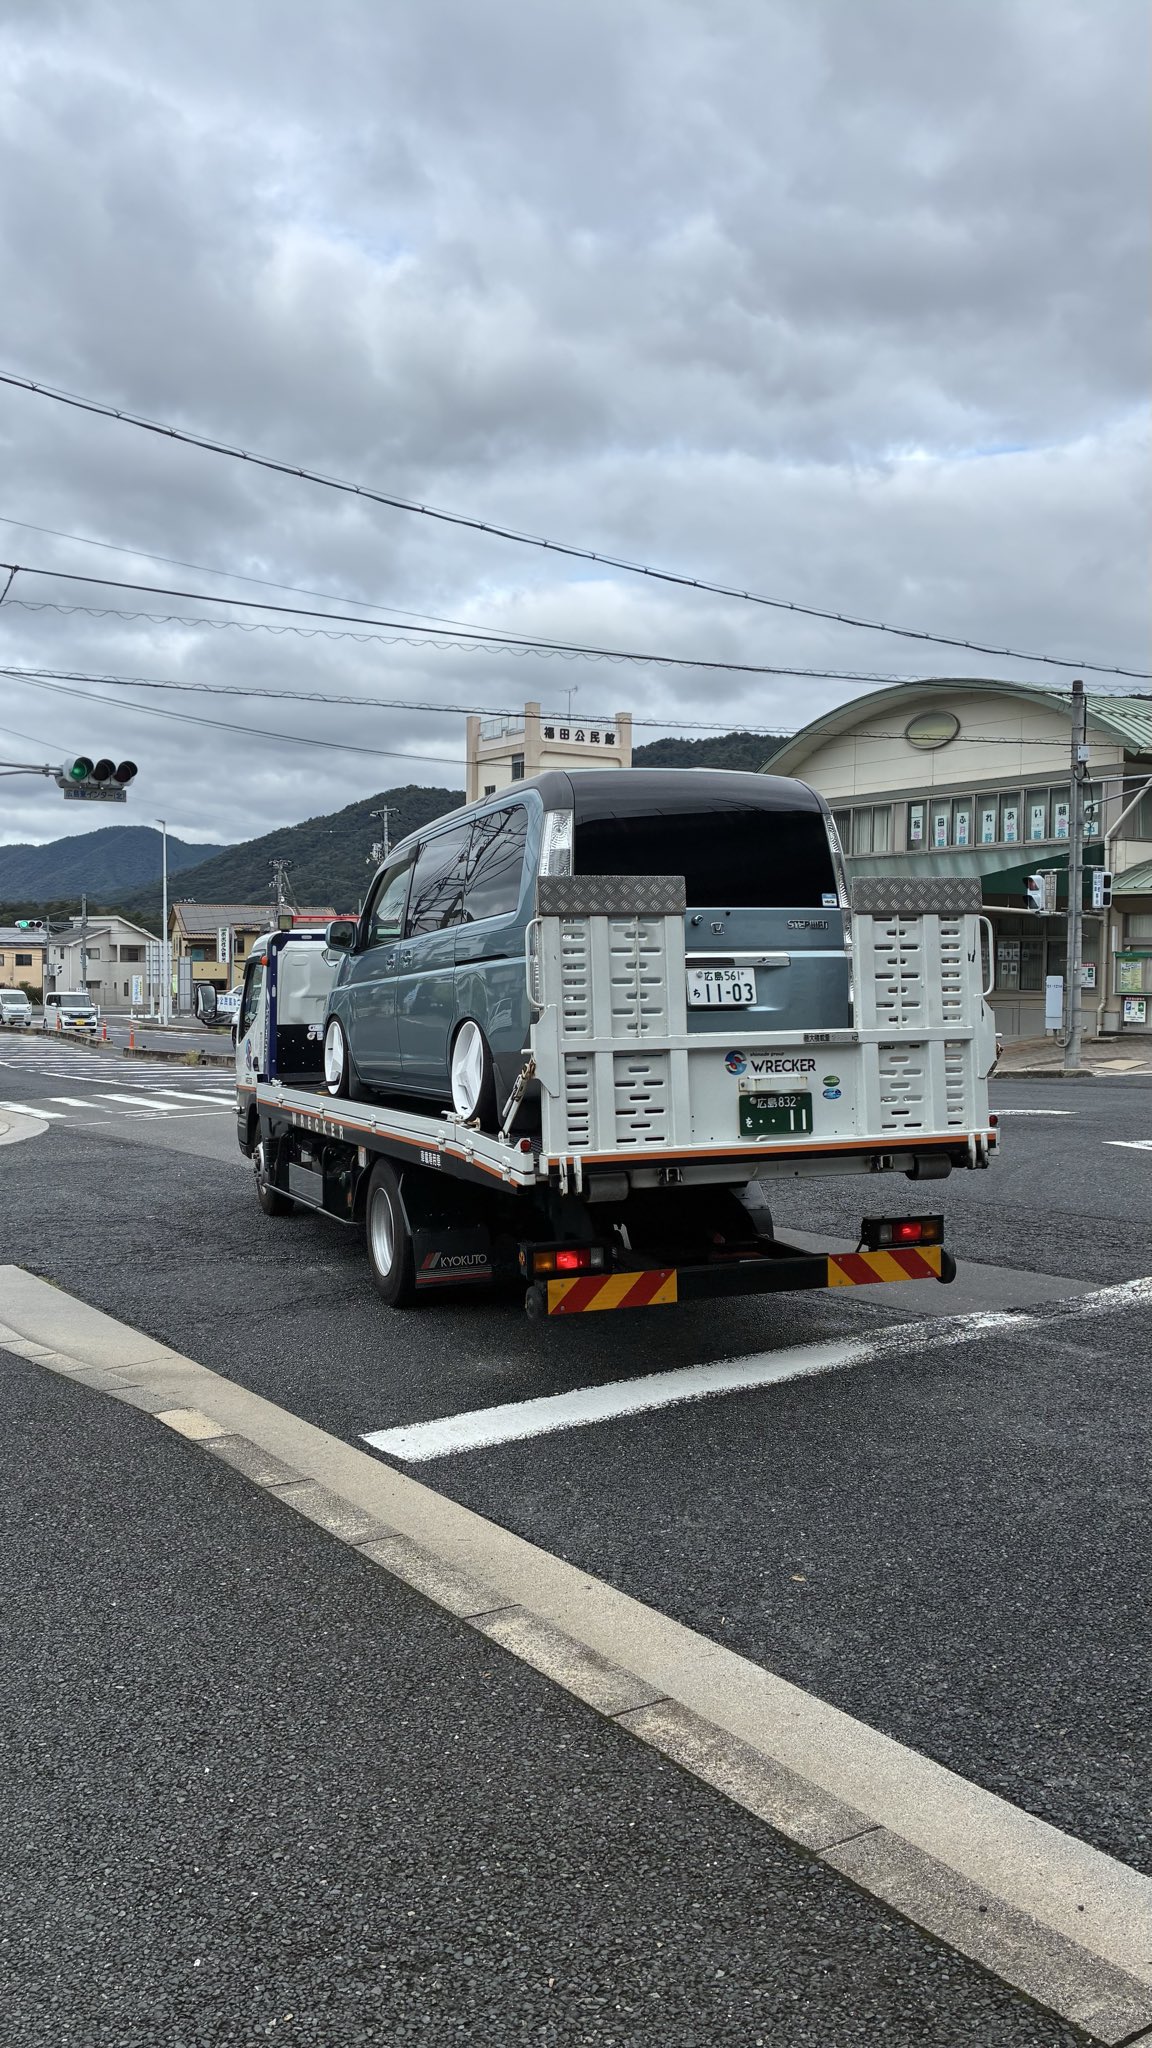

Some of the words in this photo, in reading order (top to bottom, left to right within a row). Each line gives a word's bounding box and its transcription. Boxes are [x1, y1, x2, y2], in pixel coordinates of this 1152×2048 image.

[544, 726, 615, 745] 福田公民館
[693, 988, 701, 998] ち
[706, 983, 753, 1002] 11-03
[751, 1059, 816, 1073] WRECKER
[292, 1111, 344, 1140] WRECKER
[745, 1117, 753, 1128] を
[440, 1254, 487, 1268] KYOKUTO
